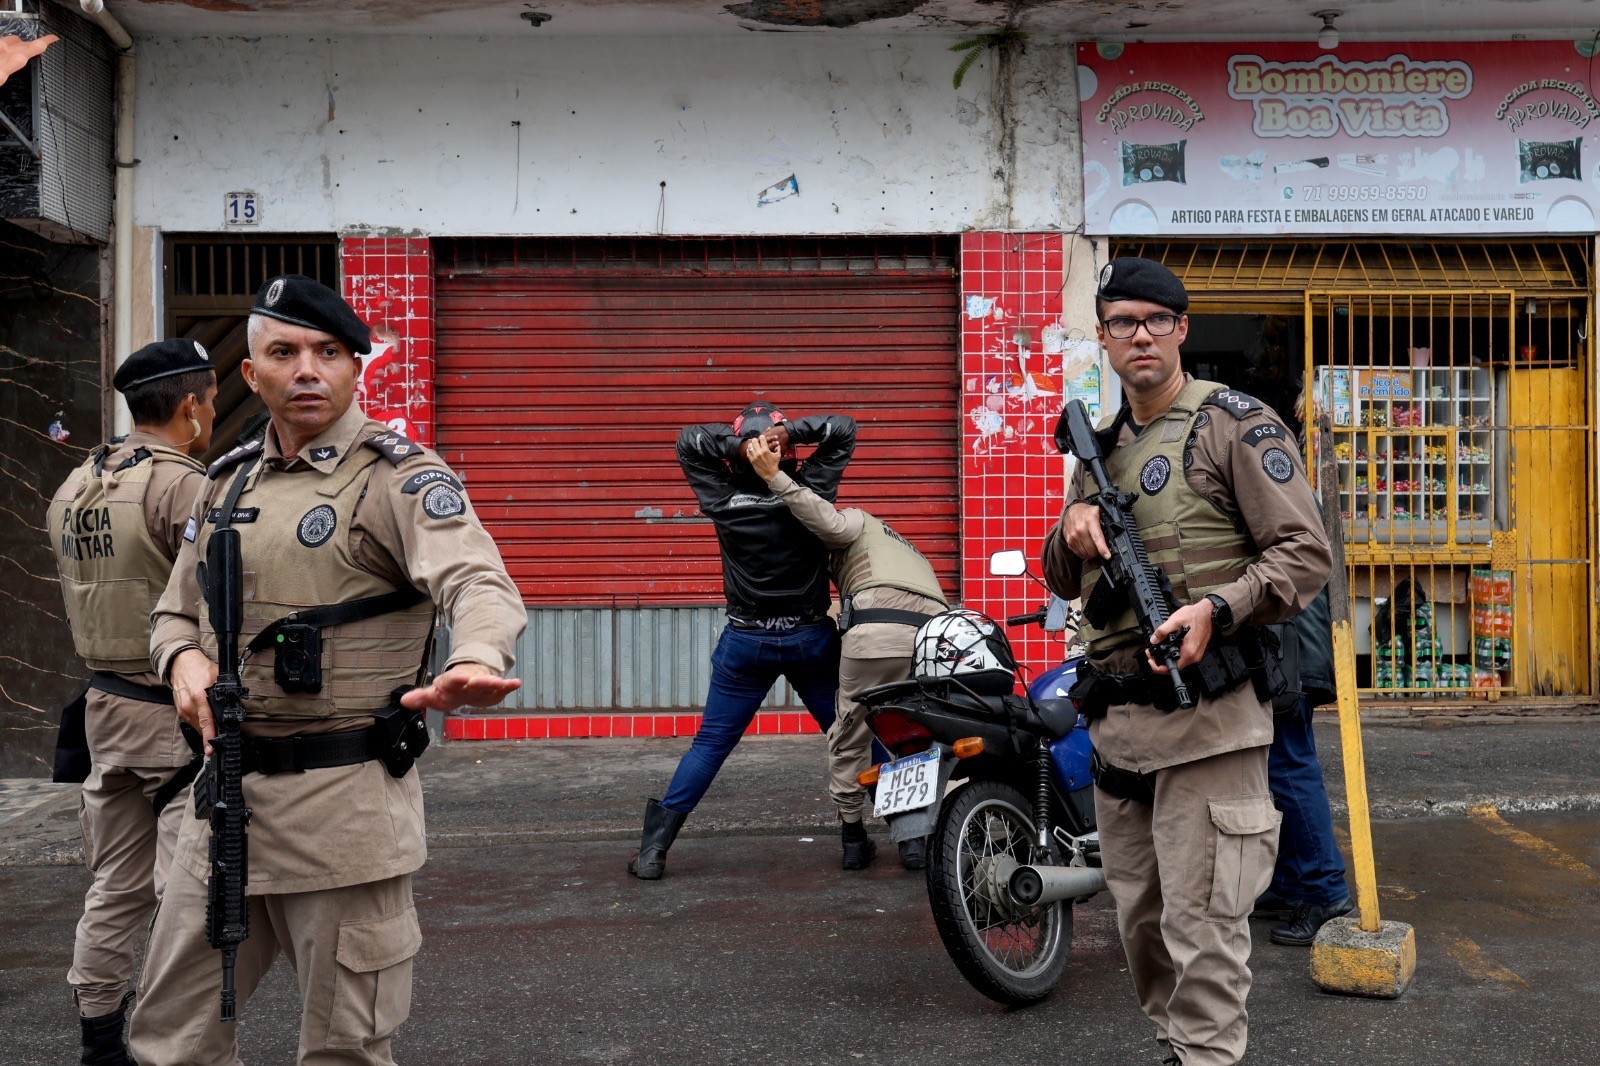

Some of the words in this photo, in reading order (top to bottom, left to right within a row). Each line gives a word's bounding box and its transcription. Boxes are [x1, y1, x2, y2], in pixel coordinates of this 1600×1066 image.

[1234, 62, 1467, 94] Bomboniere
[1098, 82, 1142, 121] COCADA
[1144, 81, 1205, 122] RECHEADA
[1495, 81, 1539, 119] COCADA
[1541, 79, 1600, 119] RECHEADA
[1109, 102, 1194, 134] APROVADA
[1259, 101, 1333, 131] Boa
[1339, 101, 1443, 131] Vista
[1506, 99, 1591, 133] APROVADA
[1303, 186, 1322, 201] 71
[1328, 185, 1428, 201] 99959-8550
[229, 199, 256, 219] 15
[1171, 209, 1212, 224] ARTIGO
[1215, 209, 1245, 223] PARA
[1247, 209, 1282, 223] FESTA
[1284, 209, 1291, 223] E
[1294, 208, 1369, 223] EMBALAGENS
[1372, 208, 1388, 222] EM
[1391, 208, 1427, 222] GERAL
[1429, 207, 1481, 222] ATACADO
[1483, 207, 1490, 221] E
[1493, 207, 1534, 221] VAREJO
[1254, 426, 1277, 437] DCS
[62, 533, 115, 561] MILITAR
[890, 763, 926, 790] MCG
[900, 757, 922, 769] BRASIL
[881, 782, 929, 811] 3F79
